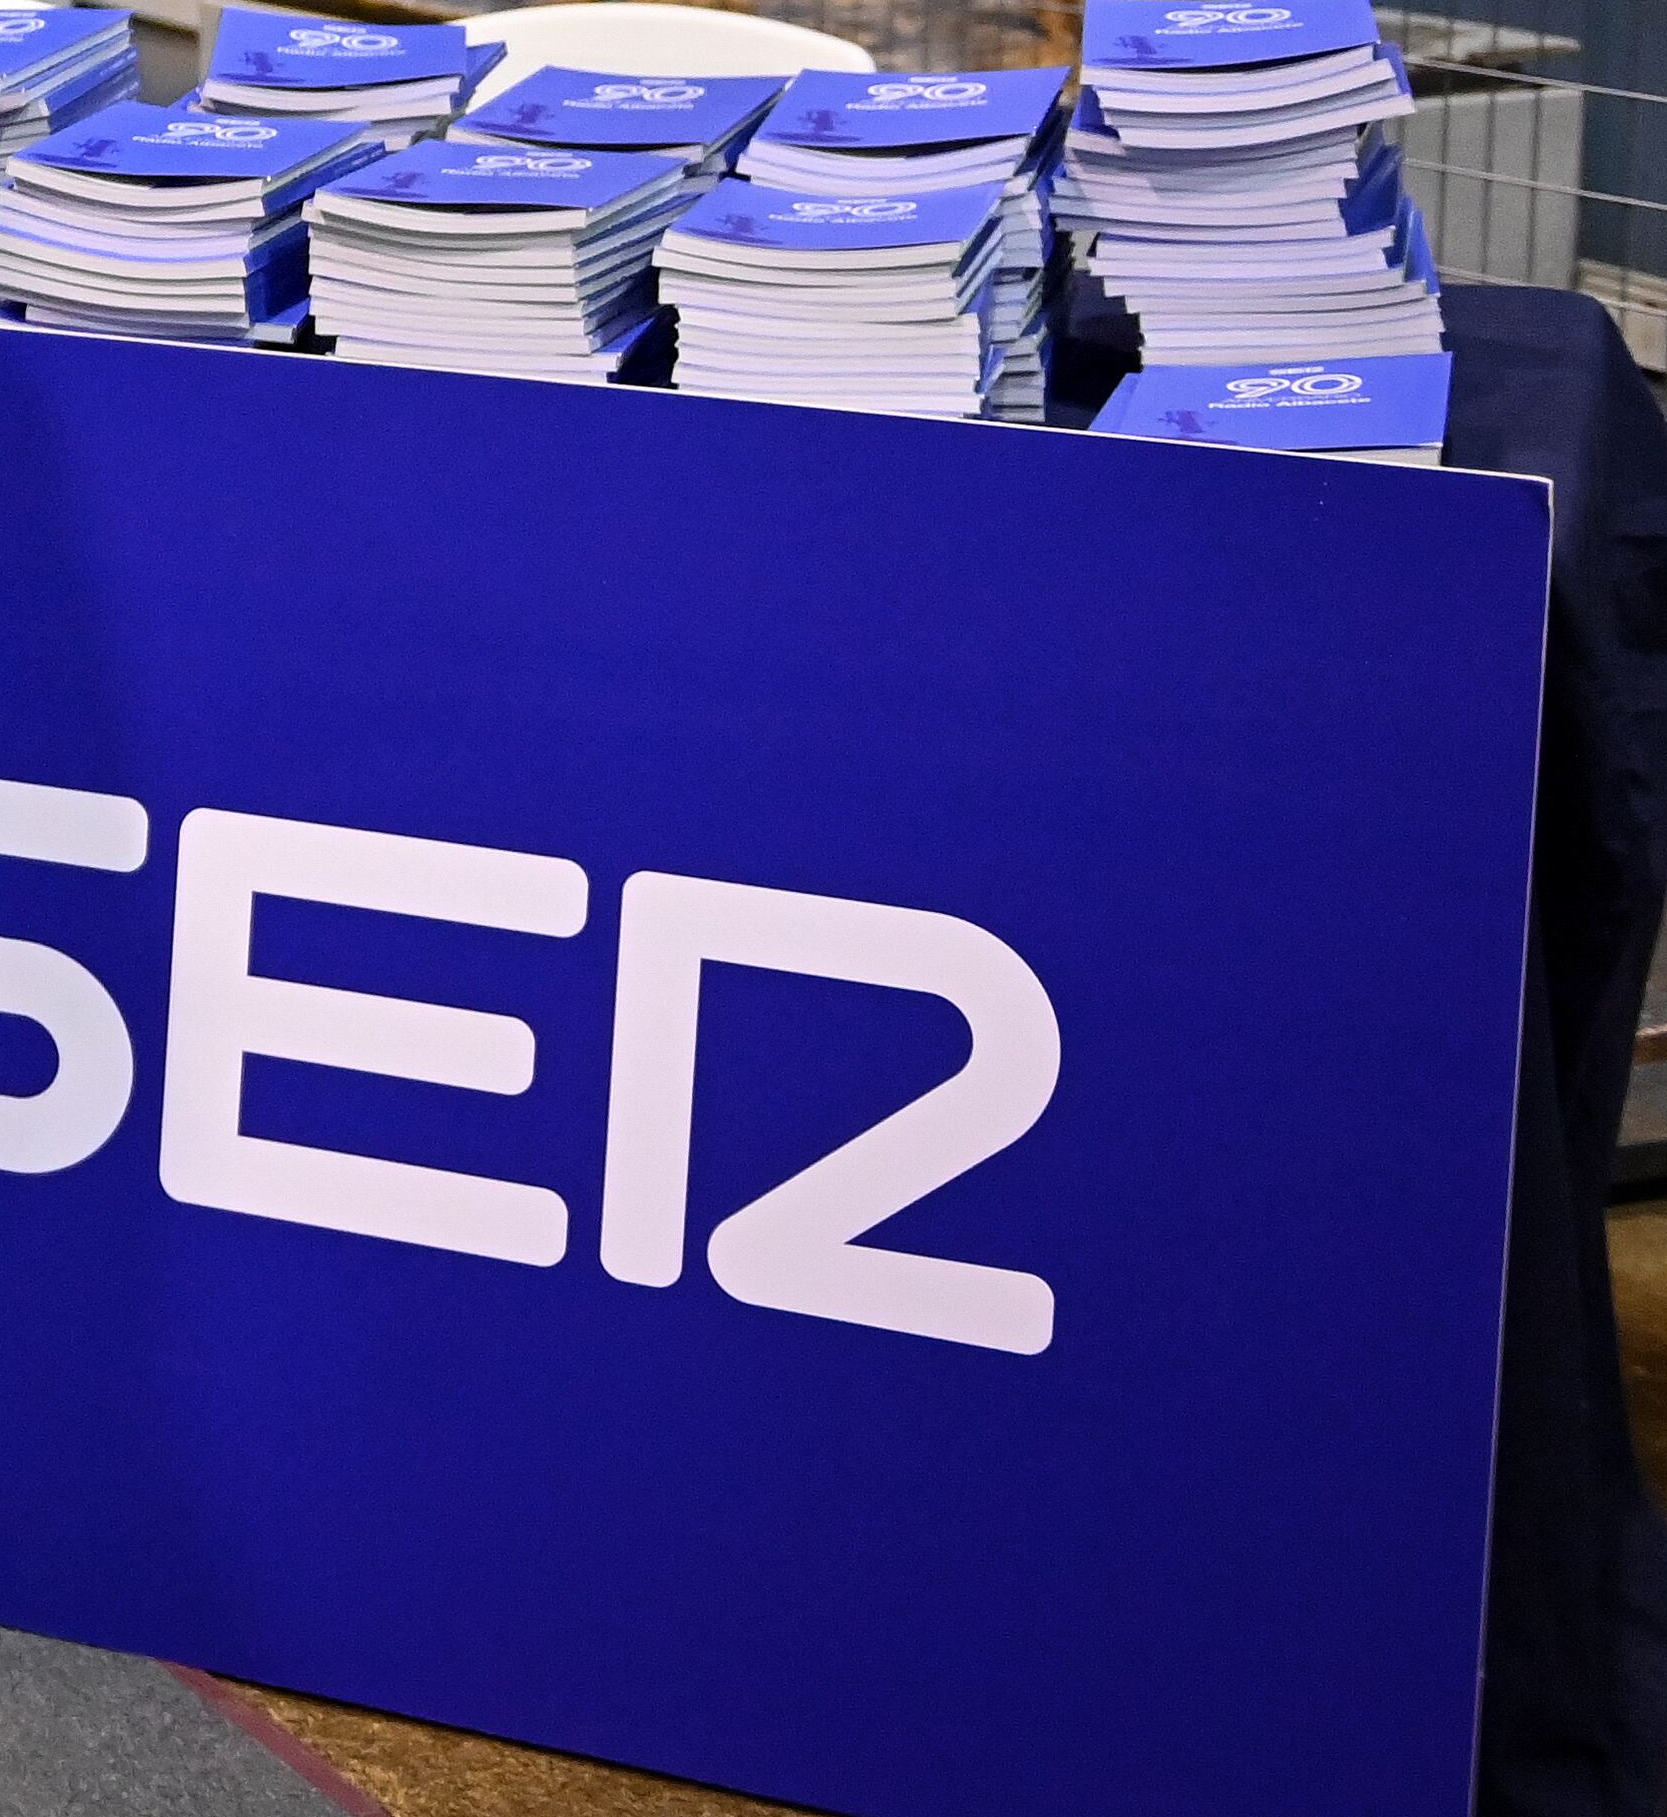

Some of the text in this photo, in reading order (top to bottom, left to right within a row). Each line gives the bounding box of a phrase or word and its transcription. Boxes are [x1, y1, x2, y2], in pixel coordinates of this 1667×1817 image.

[1164, 7, 1292, 26] 90
[288, 29, 399, 50] 90
[593, 83, 706, 102] 90
[866, 82, 987, 102] 90
[167, 122, 278, 141] 90
[474, 154, 593, 172] 90
[792, 201, 918, 217] 90
[1226, 373, 1364, 399] 90
[1207, 400, 1271, 410] Radio
[1275, 396, 1372, 409] Albacete
